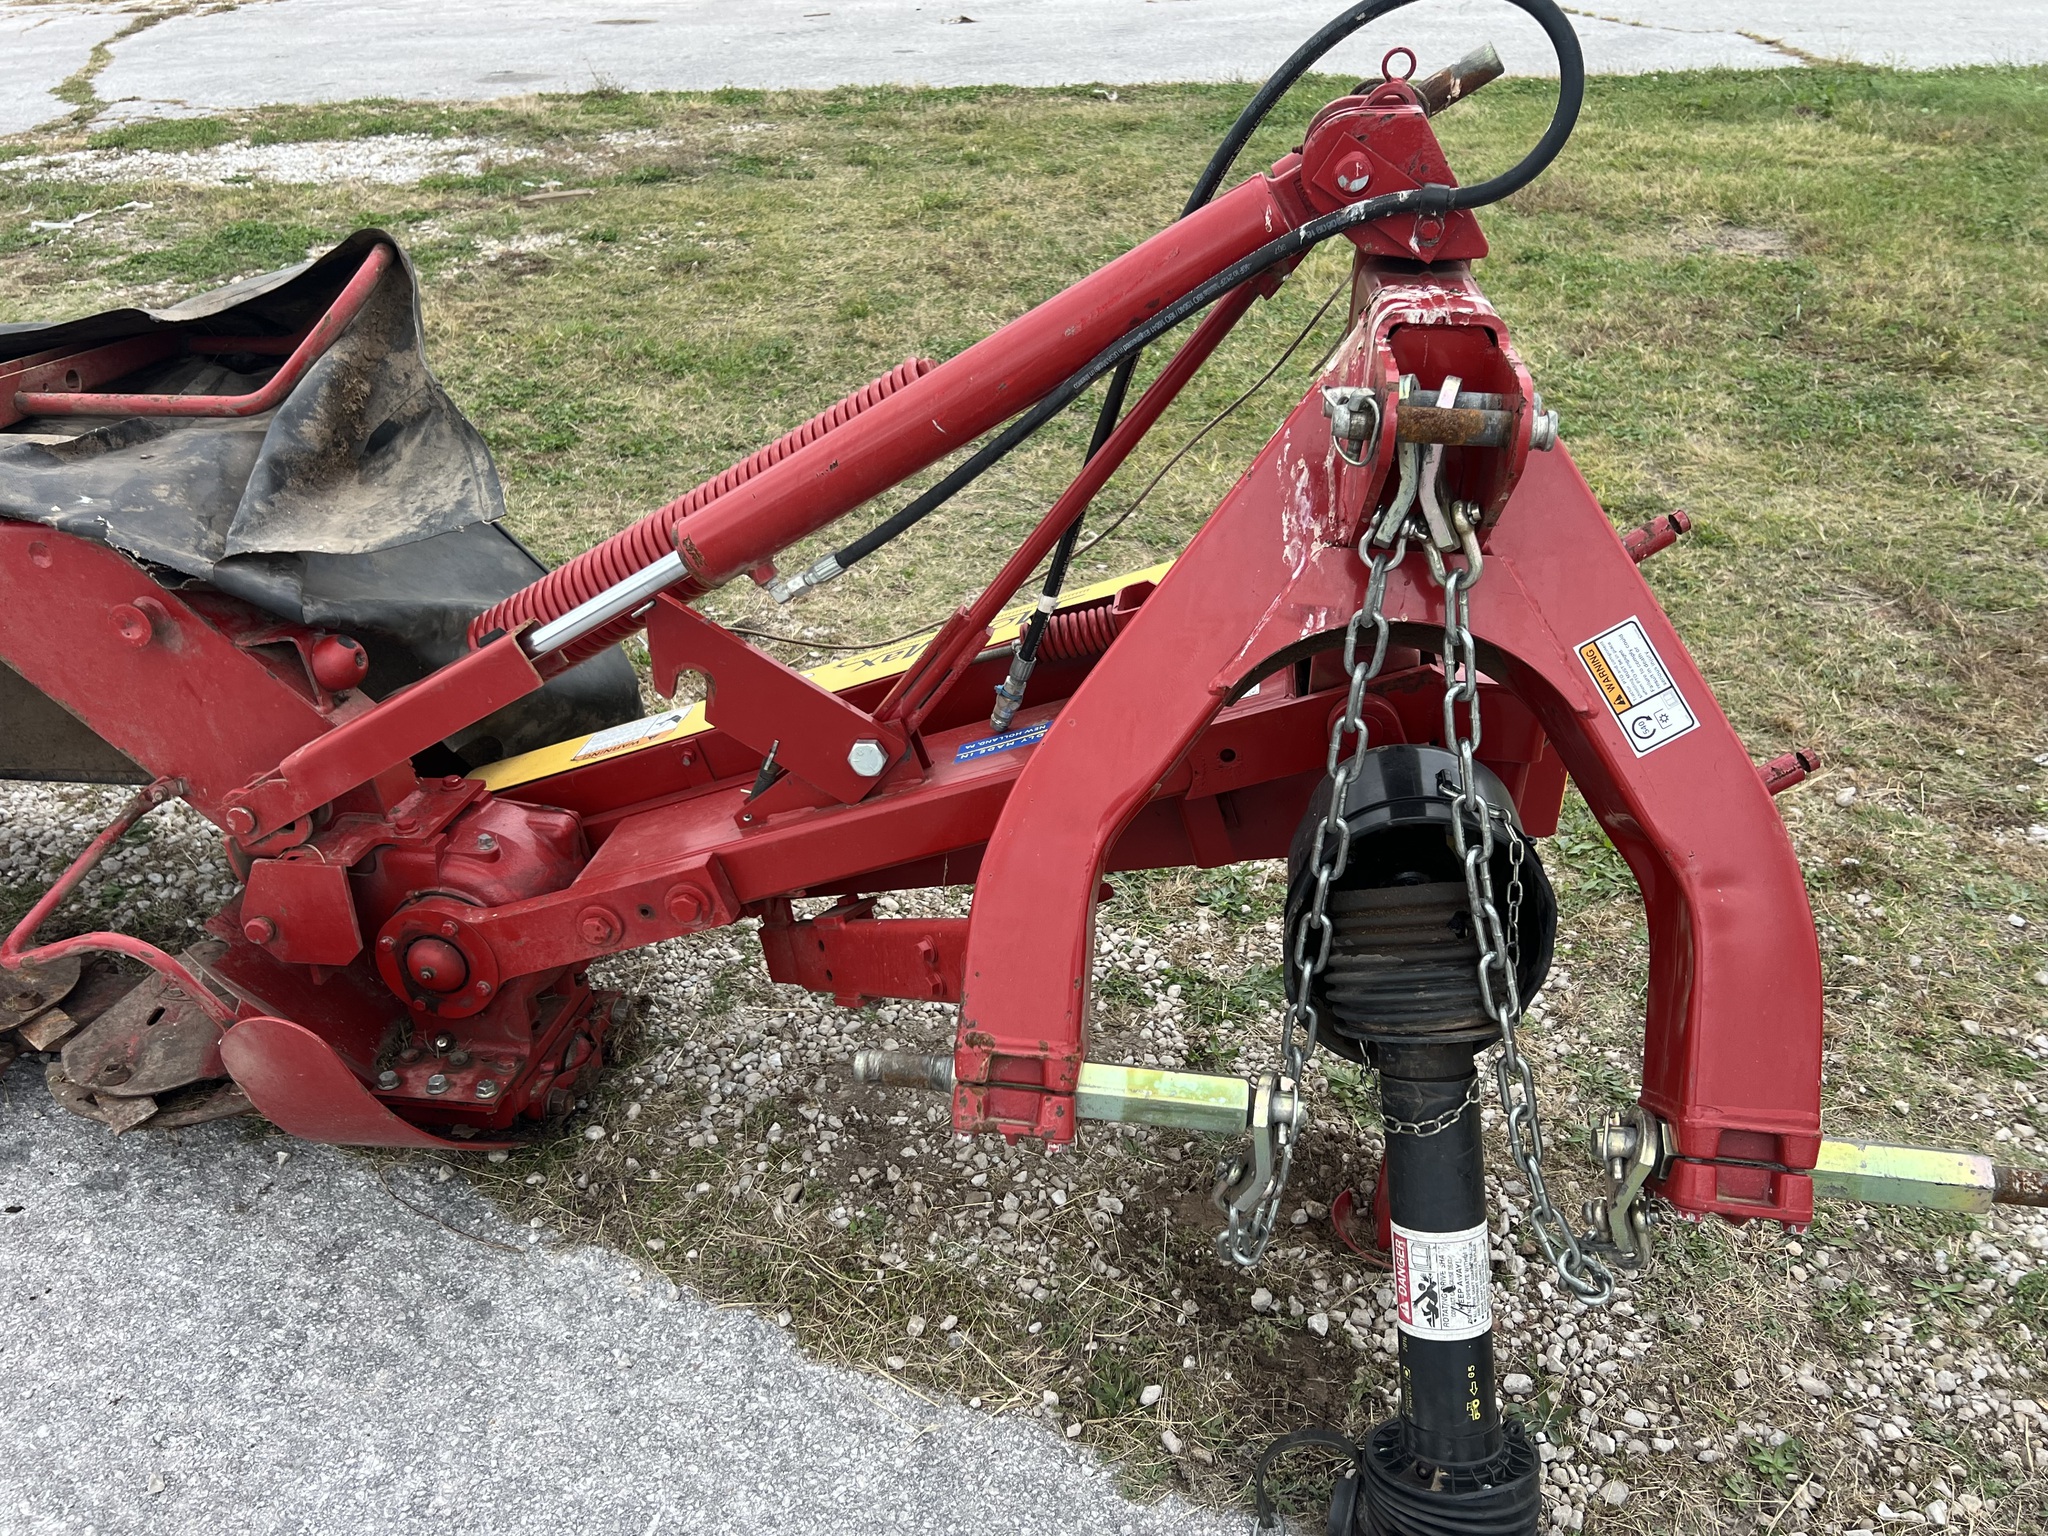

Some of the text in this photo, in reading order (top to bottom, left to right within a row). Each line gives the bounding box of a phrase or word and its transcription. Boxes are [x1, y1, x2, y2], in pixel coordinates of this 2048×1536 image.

[1192, 292, 1204, 304] ISO
[1618, 633, 1630, 649] could
[1627, 648, 1642, 668] comply
[1637, 652, 1648, 668] death
[1585, 648, 1616, 693] WARNING
[1620, 665, 1631, 678] MUST
[1653, 666, 1667, 686] serious
[1642, 674, 1655, 692] Failure
[1649, 673, 1661, 689] result
[1024, 724, 1046, 734] NEW
[1637, 720, 1650, 735] 540
[582, 740, 640, 760] WARNING
[979, 741, 1015, 754] MADE
[1394, 1238, 1408, 1297] DANGER
[1457, 1288, 1465, 1310] KEEP
[1441, 1293, 1449, 1327] ROTATING
